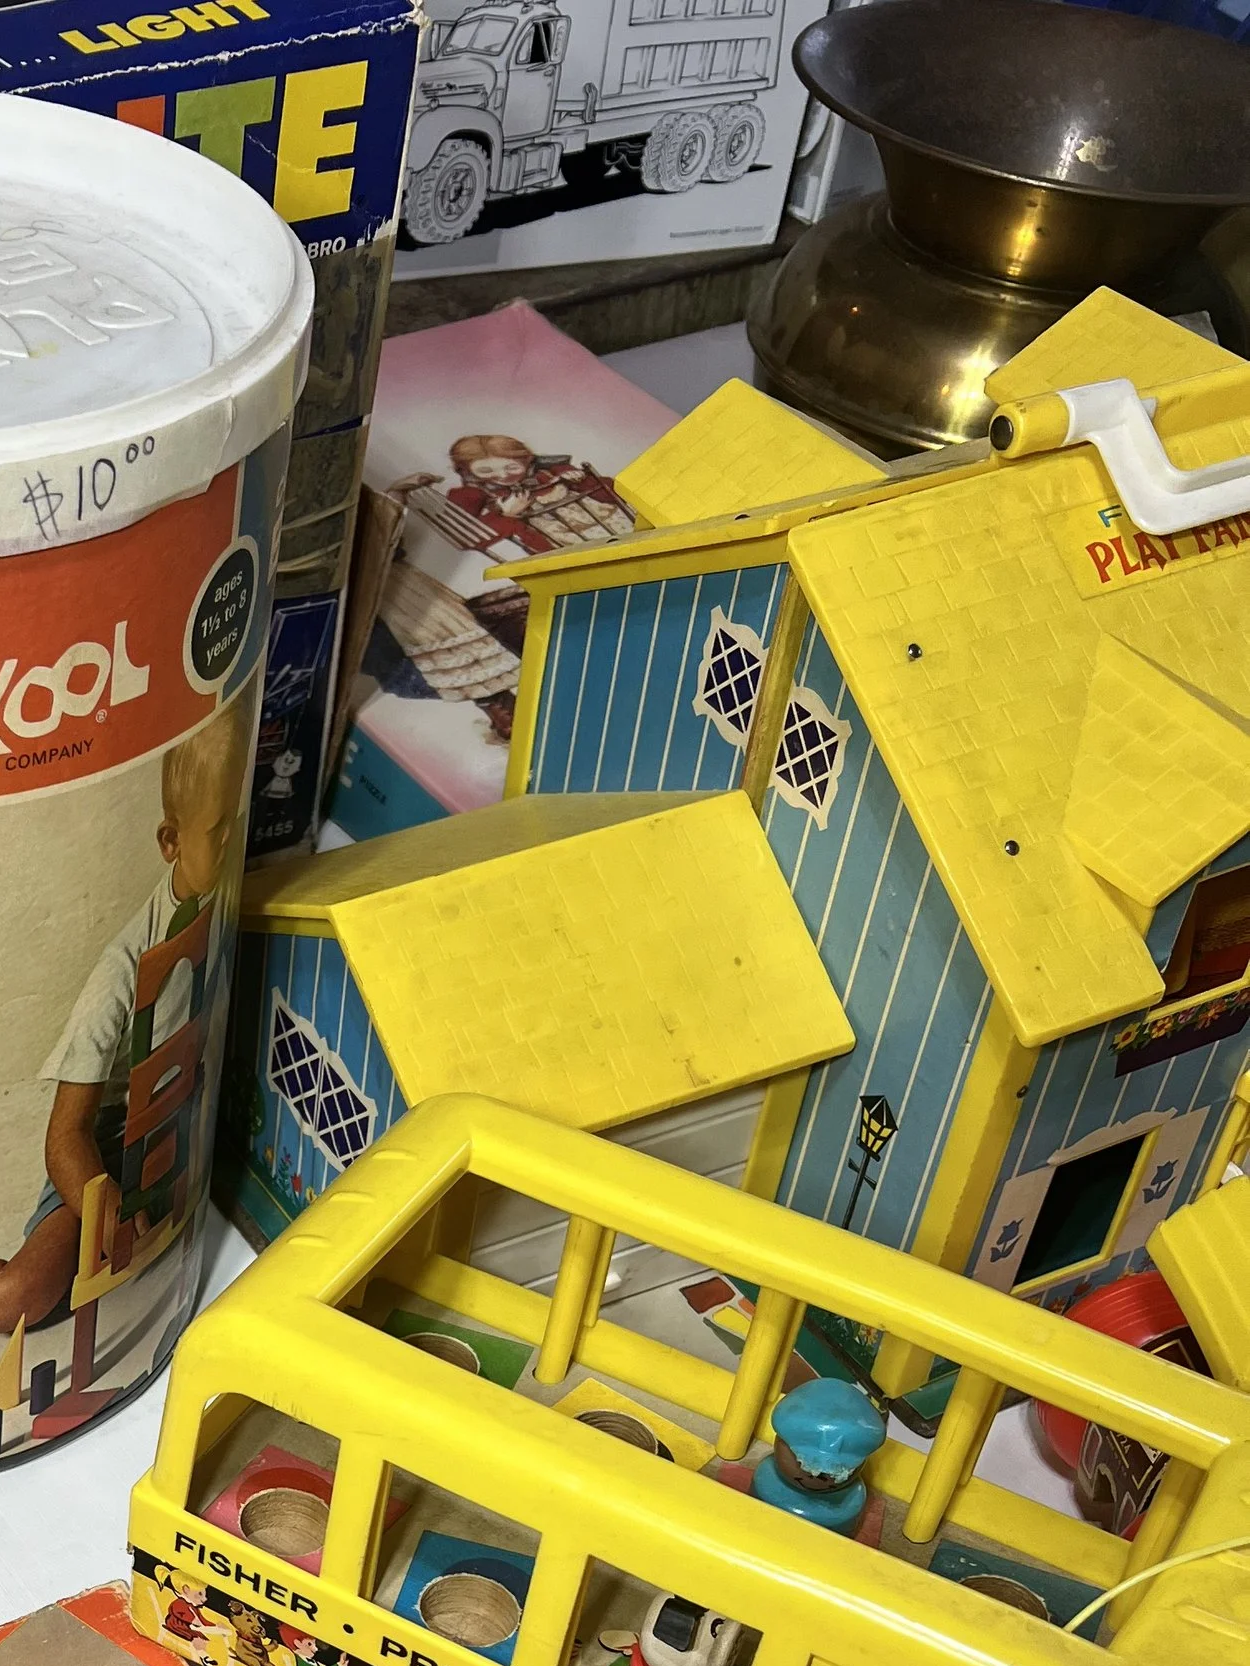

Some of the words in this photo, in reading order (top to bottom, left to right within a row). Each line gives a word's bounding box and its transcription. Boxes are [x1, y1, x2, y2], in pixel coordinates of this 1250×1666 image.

[56, 0, 268, 54] LIGHT
[304, 237, 347, 260] BRO
[214, 567, 243, 603] ages
[224, 601, 237, 623] to
[240, 589, 248, 609] 8
[206, 626, 238, 667] years
[5, 738, 96, 771] COMPANY
[175, 1531, 318, 1620] FISHER
